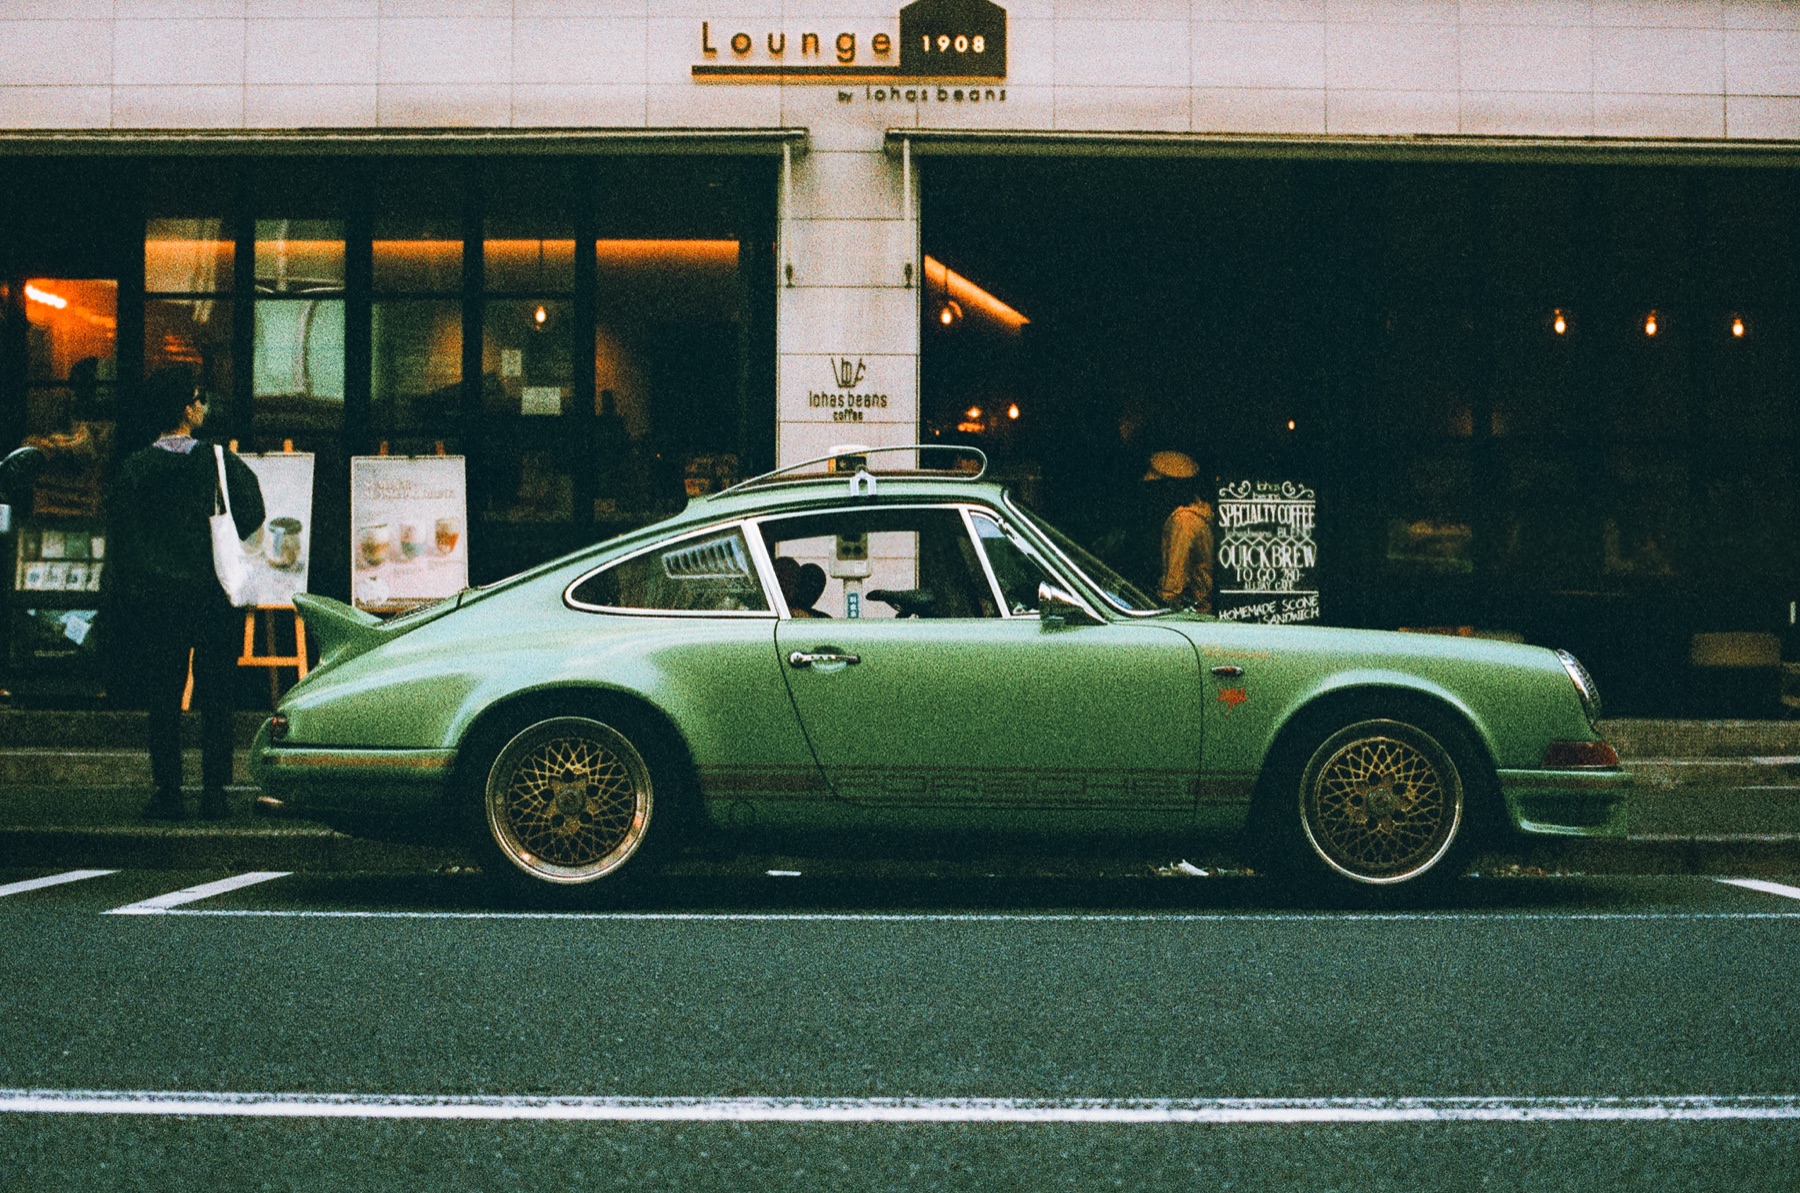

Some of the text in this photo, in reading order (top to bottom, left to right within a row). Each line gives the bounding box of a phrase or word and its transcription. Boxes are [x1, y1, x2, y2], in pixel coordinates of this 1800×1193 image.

[702, 21, 985, 63] Lounge 1908
[866, 85, 928, 102] lohas
[936, 84, 1006, 102] beans
[809, 390, 888, 408] lohas beans
[833, 408, 863, 421] coffee
[1219, 504, 1316, 529] SPECIALTY COFFEE
[1219, 545, 1317, 569] QUICK BREW
[1236, 567, 1253, 582] TO
[1257, 566, 1276, 582] GO
[1219, 594, 1319, 620] HOMEMADE SCONE
[1263, 606, 1319, 625] SANDWICH
